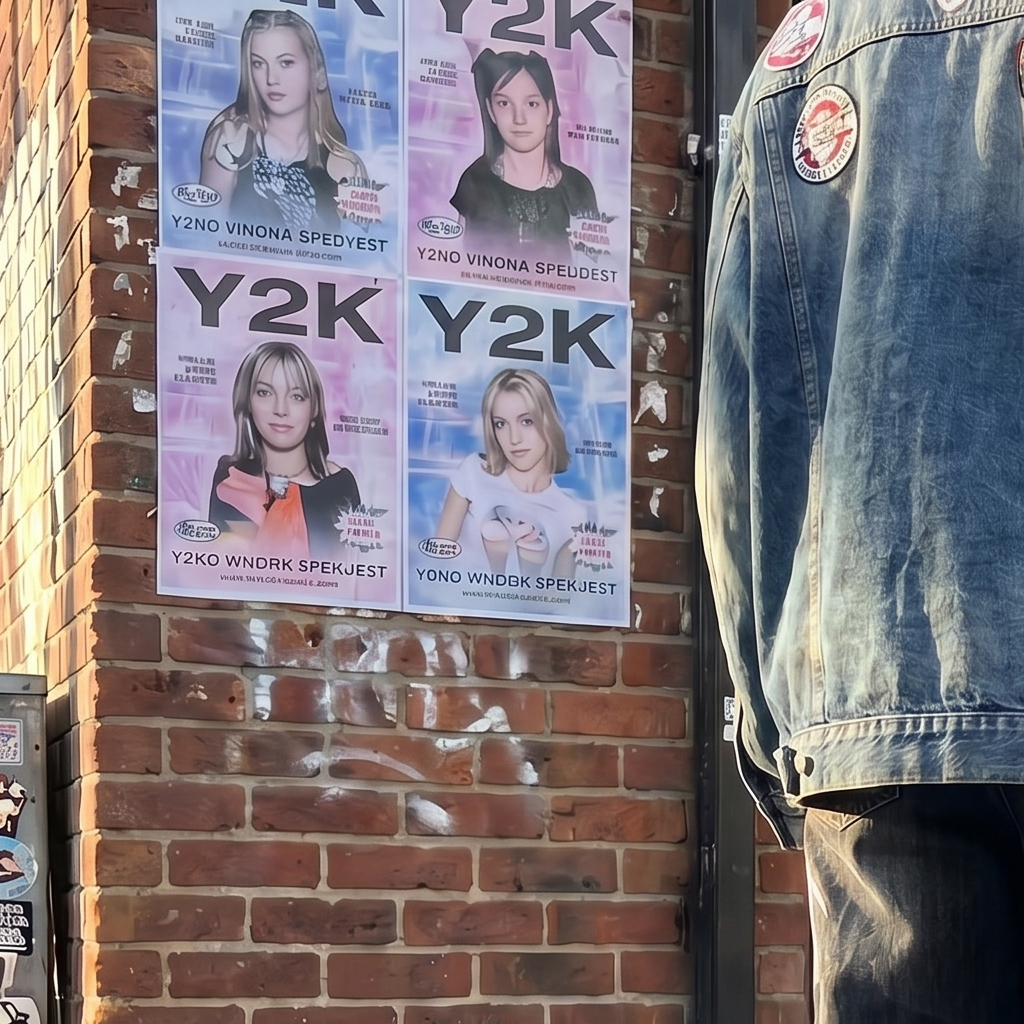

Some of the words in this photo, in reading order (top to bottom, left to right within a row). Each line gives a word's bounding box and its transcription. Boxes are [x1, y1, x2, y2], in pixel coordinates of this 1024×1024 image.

[438, 0, 618, 58] Y2K
[171, 214, 220, 233] Y2NO
[225, 221, 293, 242] VINONA
[298, 229, 389, 253] SPEDYEST
[416, 246, 461, 264] Y2NO
[466, 253, 530, 273] VINONA
[172, 266, 385, 345] Y2K
[418, 293, 616, 370] Y2K
[171, 550, 220, 567] Y2KO
[225, 554, 294, 572] WNDRK
[298, 559, 388, 578] SPEKJEST
[535, 576, 618, 596] SPEKJEST
